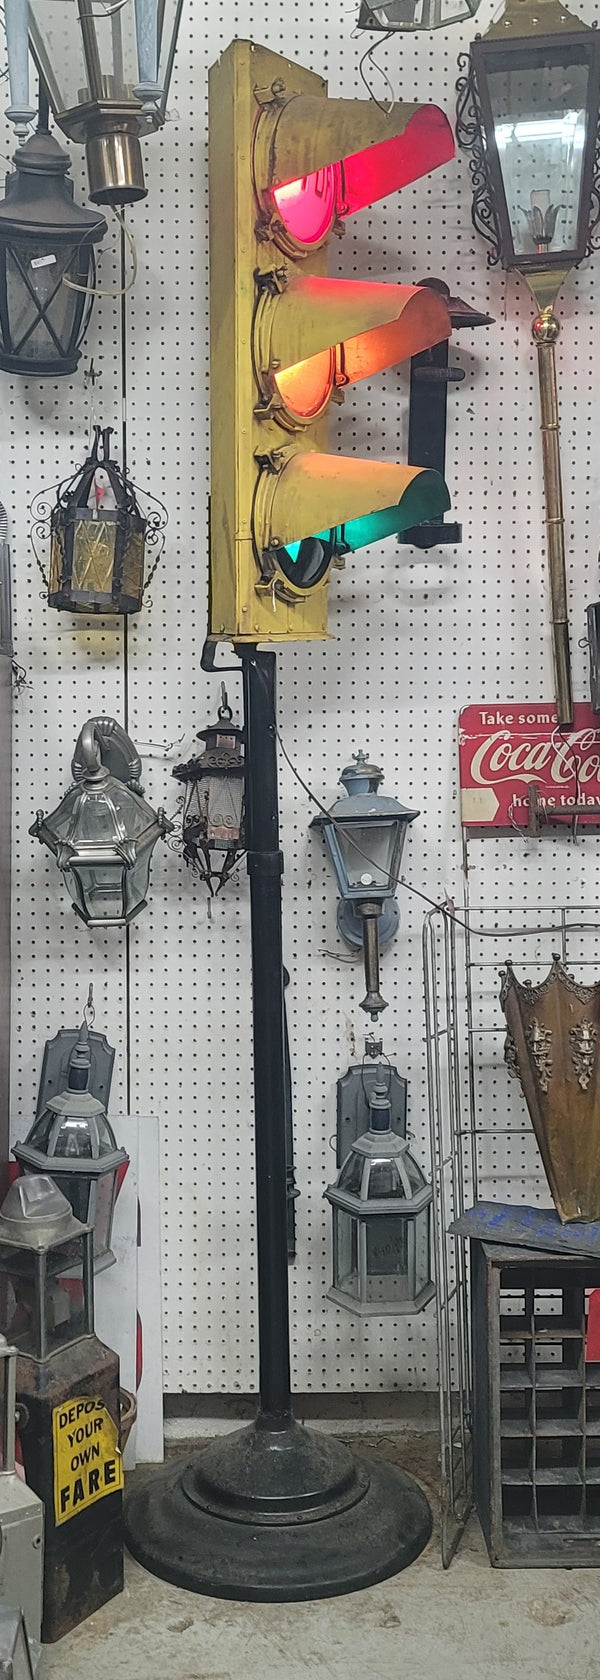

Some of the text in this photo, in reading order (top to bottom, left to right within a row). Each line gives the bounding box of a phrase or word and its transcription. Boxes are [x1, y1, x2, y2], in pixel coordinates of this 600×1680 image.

[479, 711, 558, 725] Take some
[67, 1417, 104, 1447] YOUR
[70, 1442, 100, 1472] OWN
[60, 1459, 116, 1513] FARE
